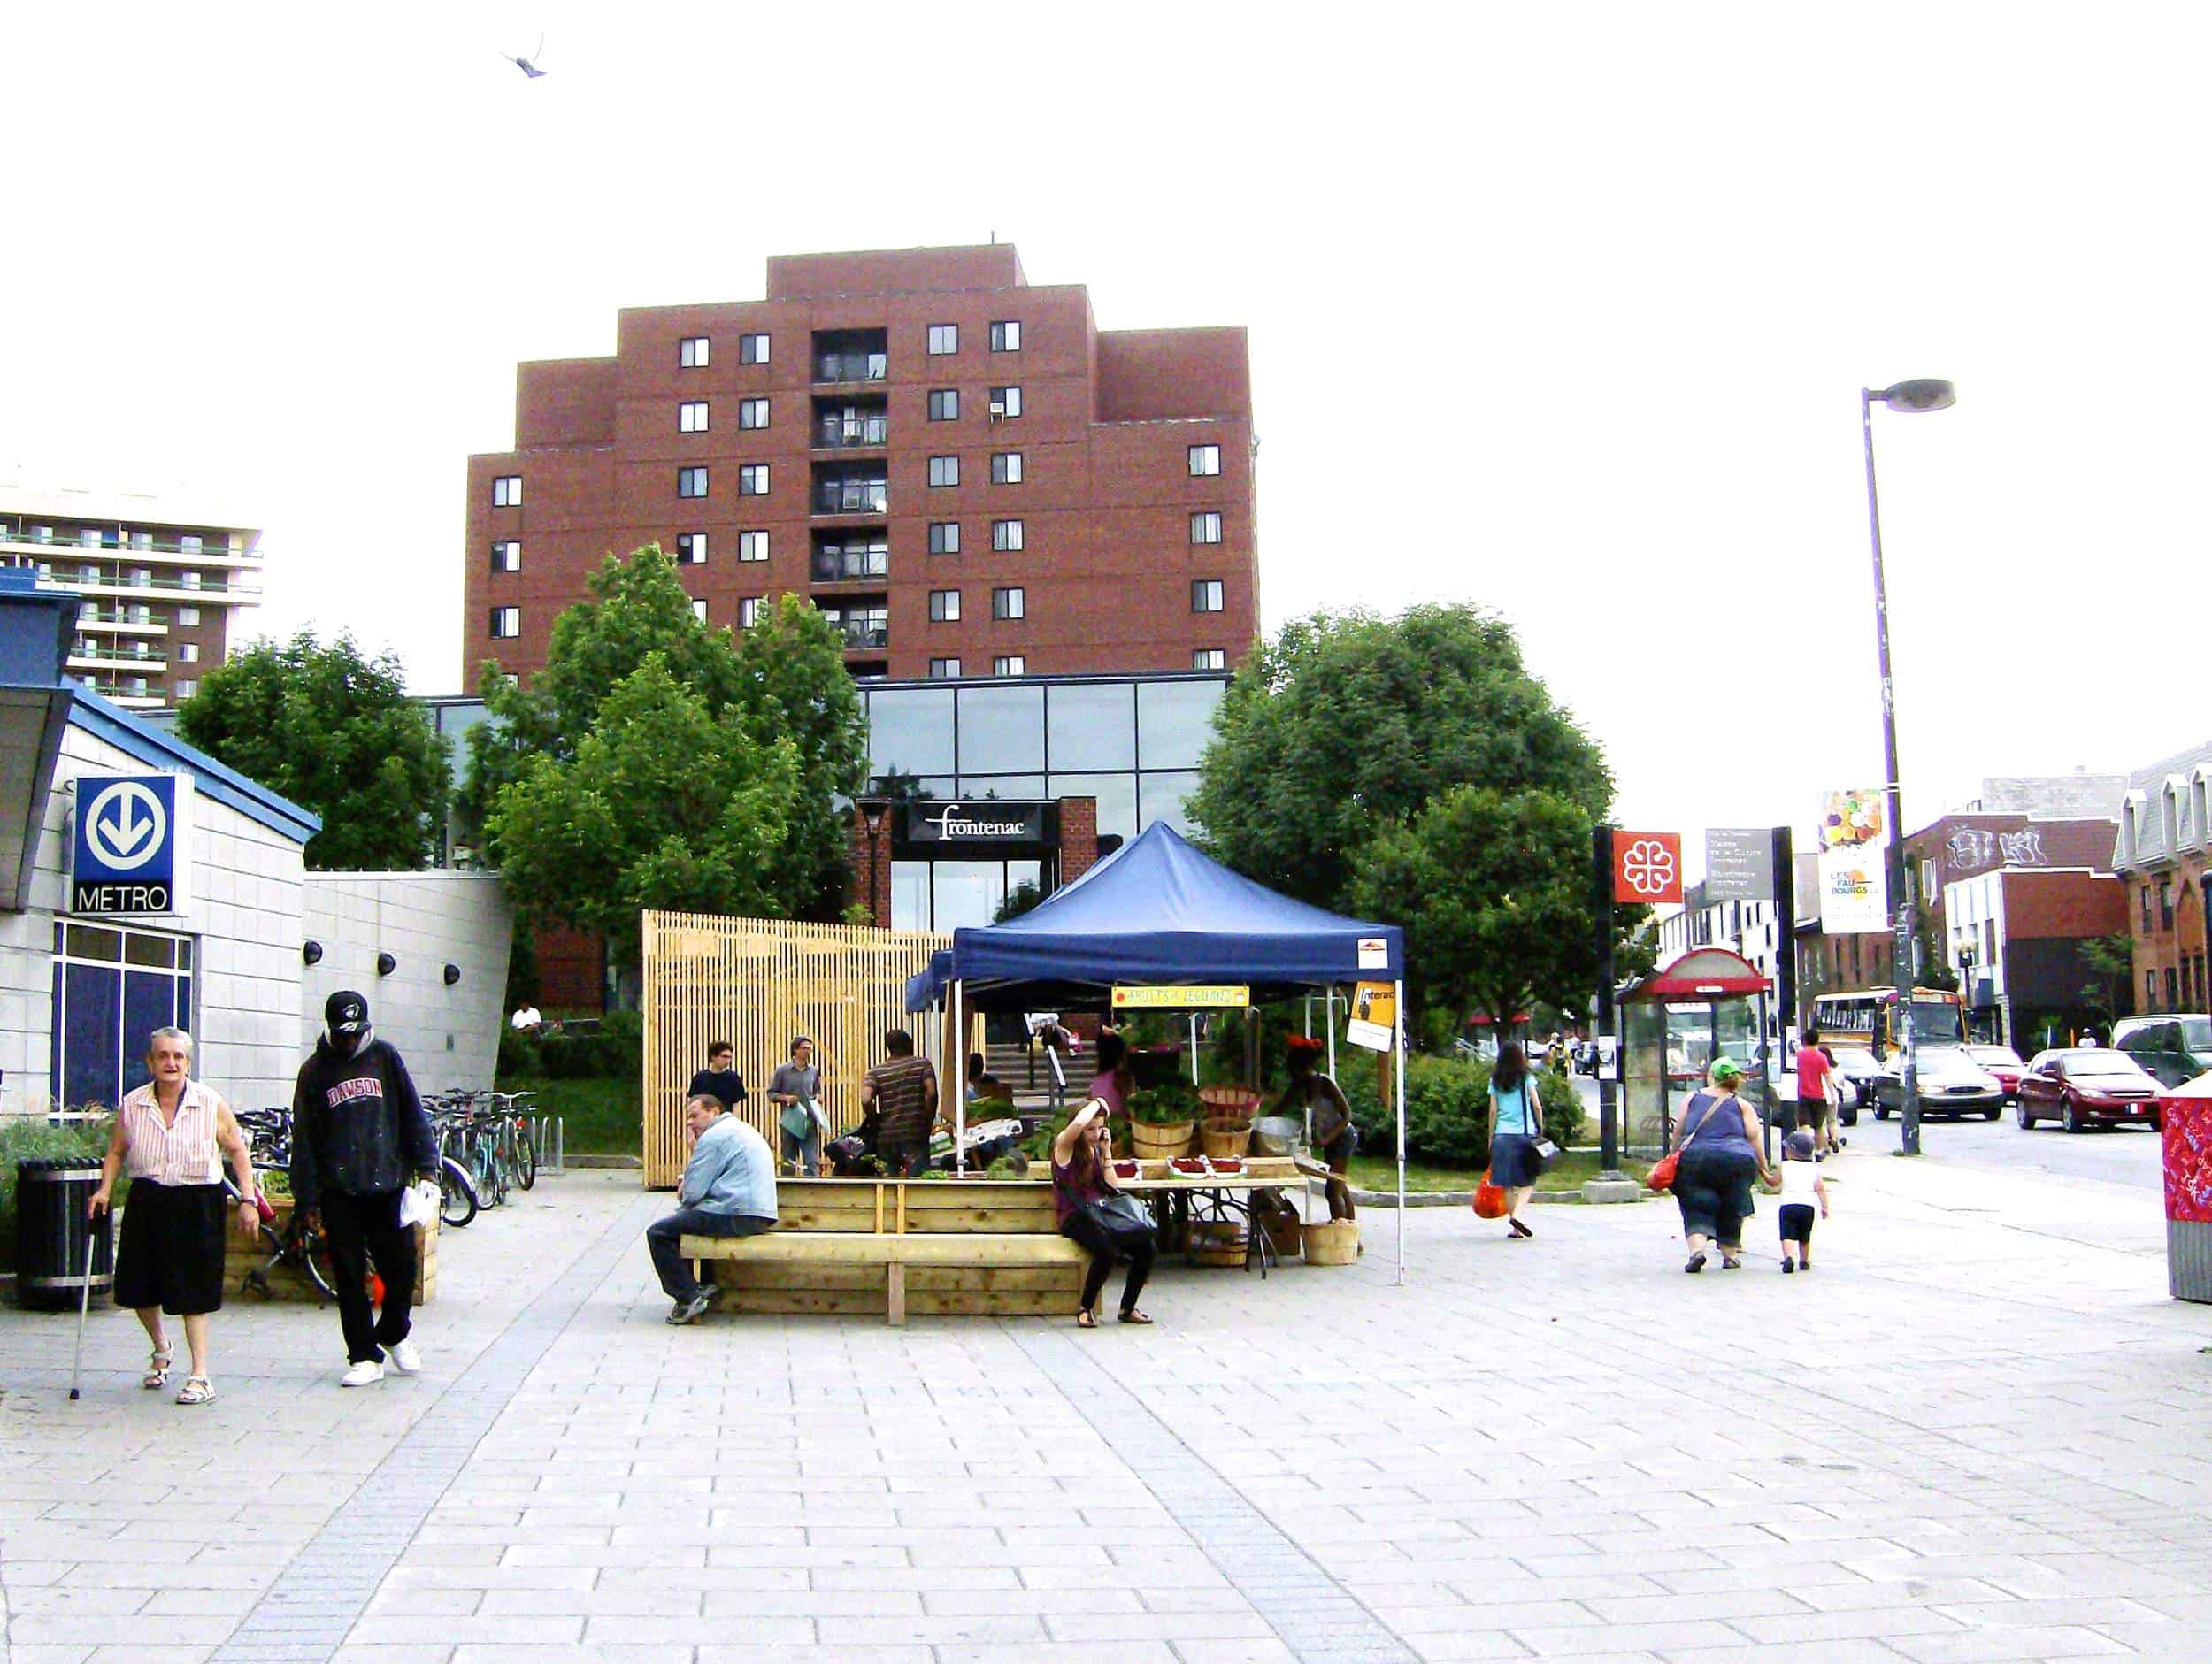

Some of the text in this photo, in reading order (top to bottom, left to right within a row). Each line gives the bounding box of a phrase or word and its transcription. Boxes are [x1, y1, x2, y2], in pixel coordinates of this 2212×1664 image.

[925, 804, 1025, 840] frontenac
[1832, 886, 1868, 895] BOURGS
[1837, 878, 1855, 887] FAU
[78, 886, 168, 912] METRO
[326, 1077, 383, 1109] DAWSON
